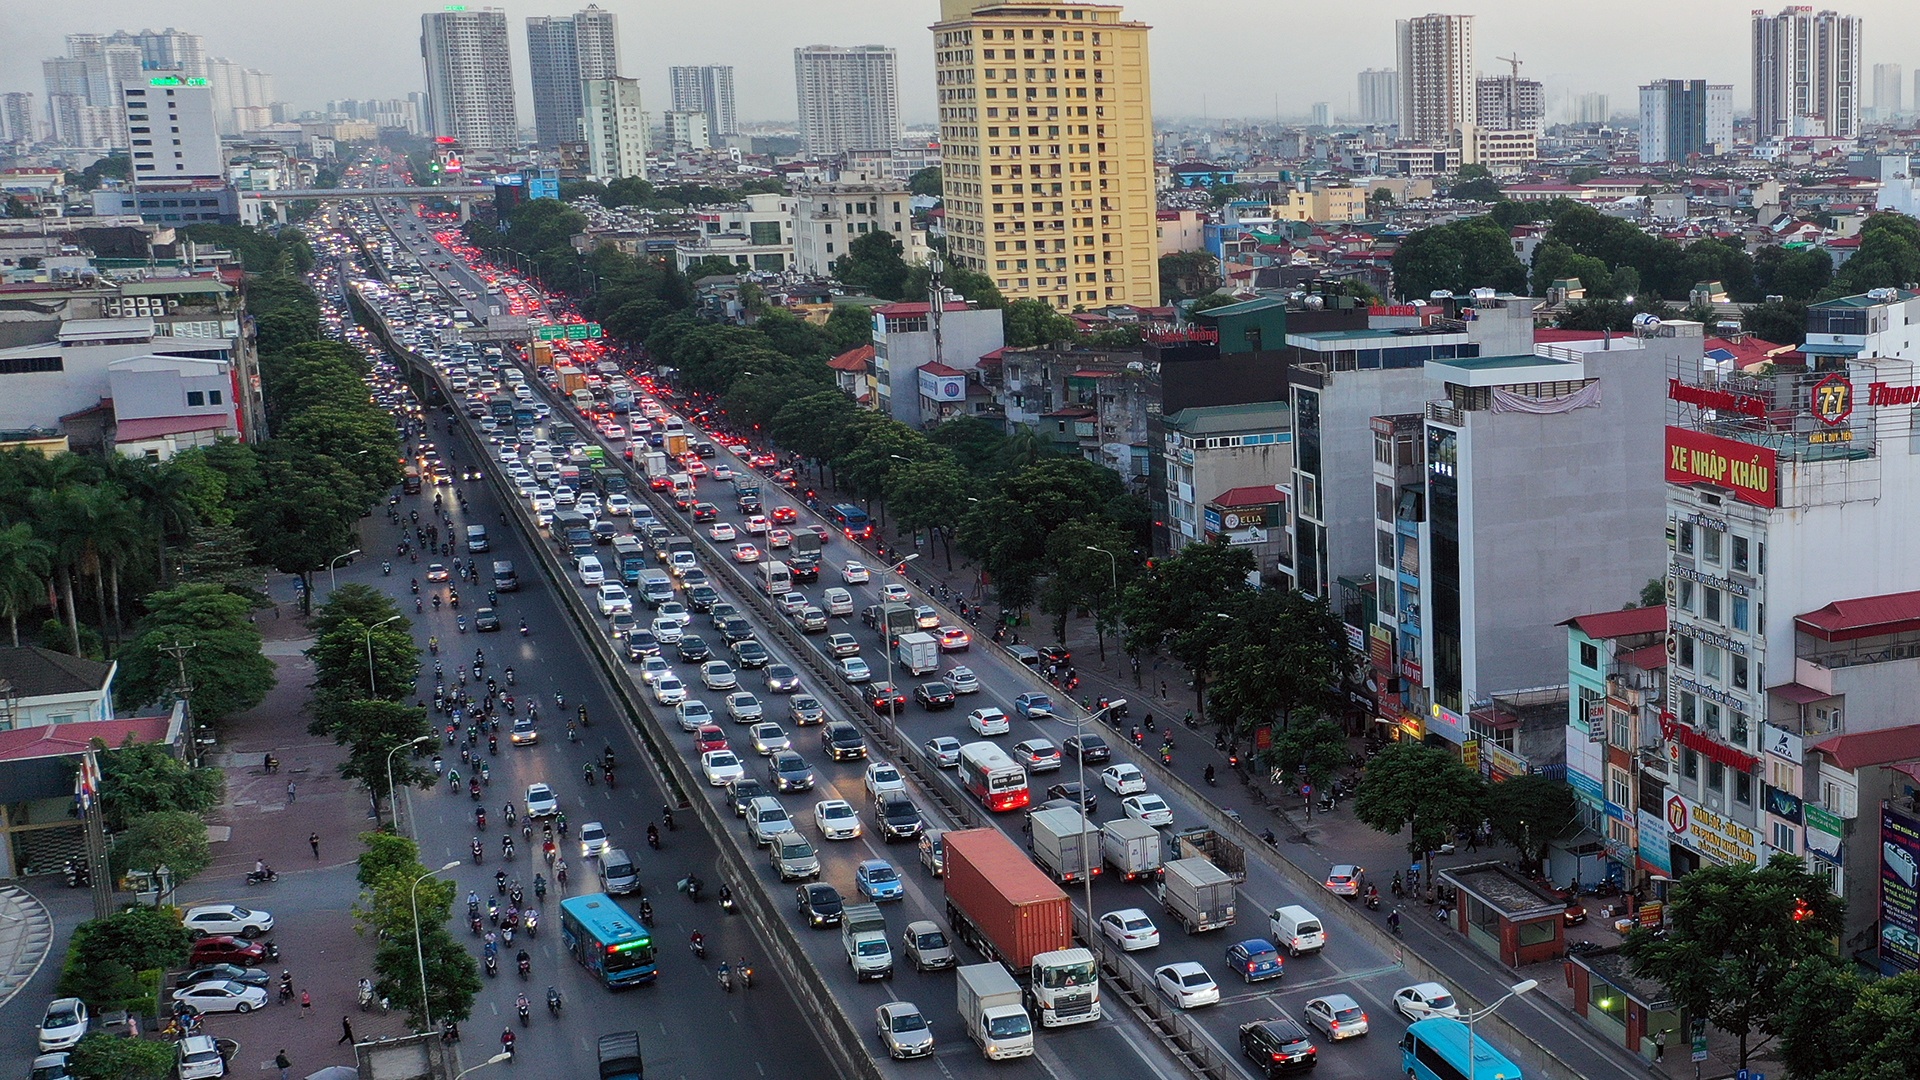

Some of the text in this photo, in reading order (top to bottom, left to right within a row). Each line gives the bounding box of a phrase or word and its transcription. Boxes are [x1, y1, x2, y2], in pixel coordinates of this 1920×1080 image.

[1389, 305, 1415, 316] OFFICE
[1820, 386, 1846, 414] 77
[1671, 445, 1768, 493] XE NHẬP KHẨU
[1240, 515, 1262, 524] ELIA
[1773, 745, 1793, 758] AKKA
